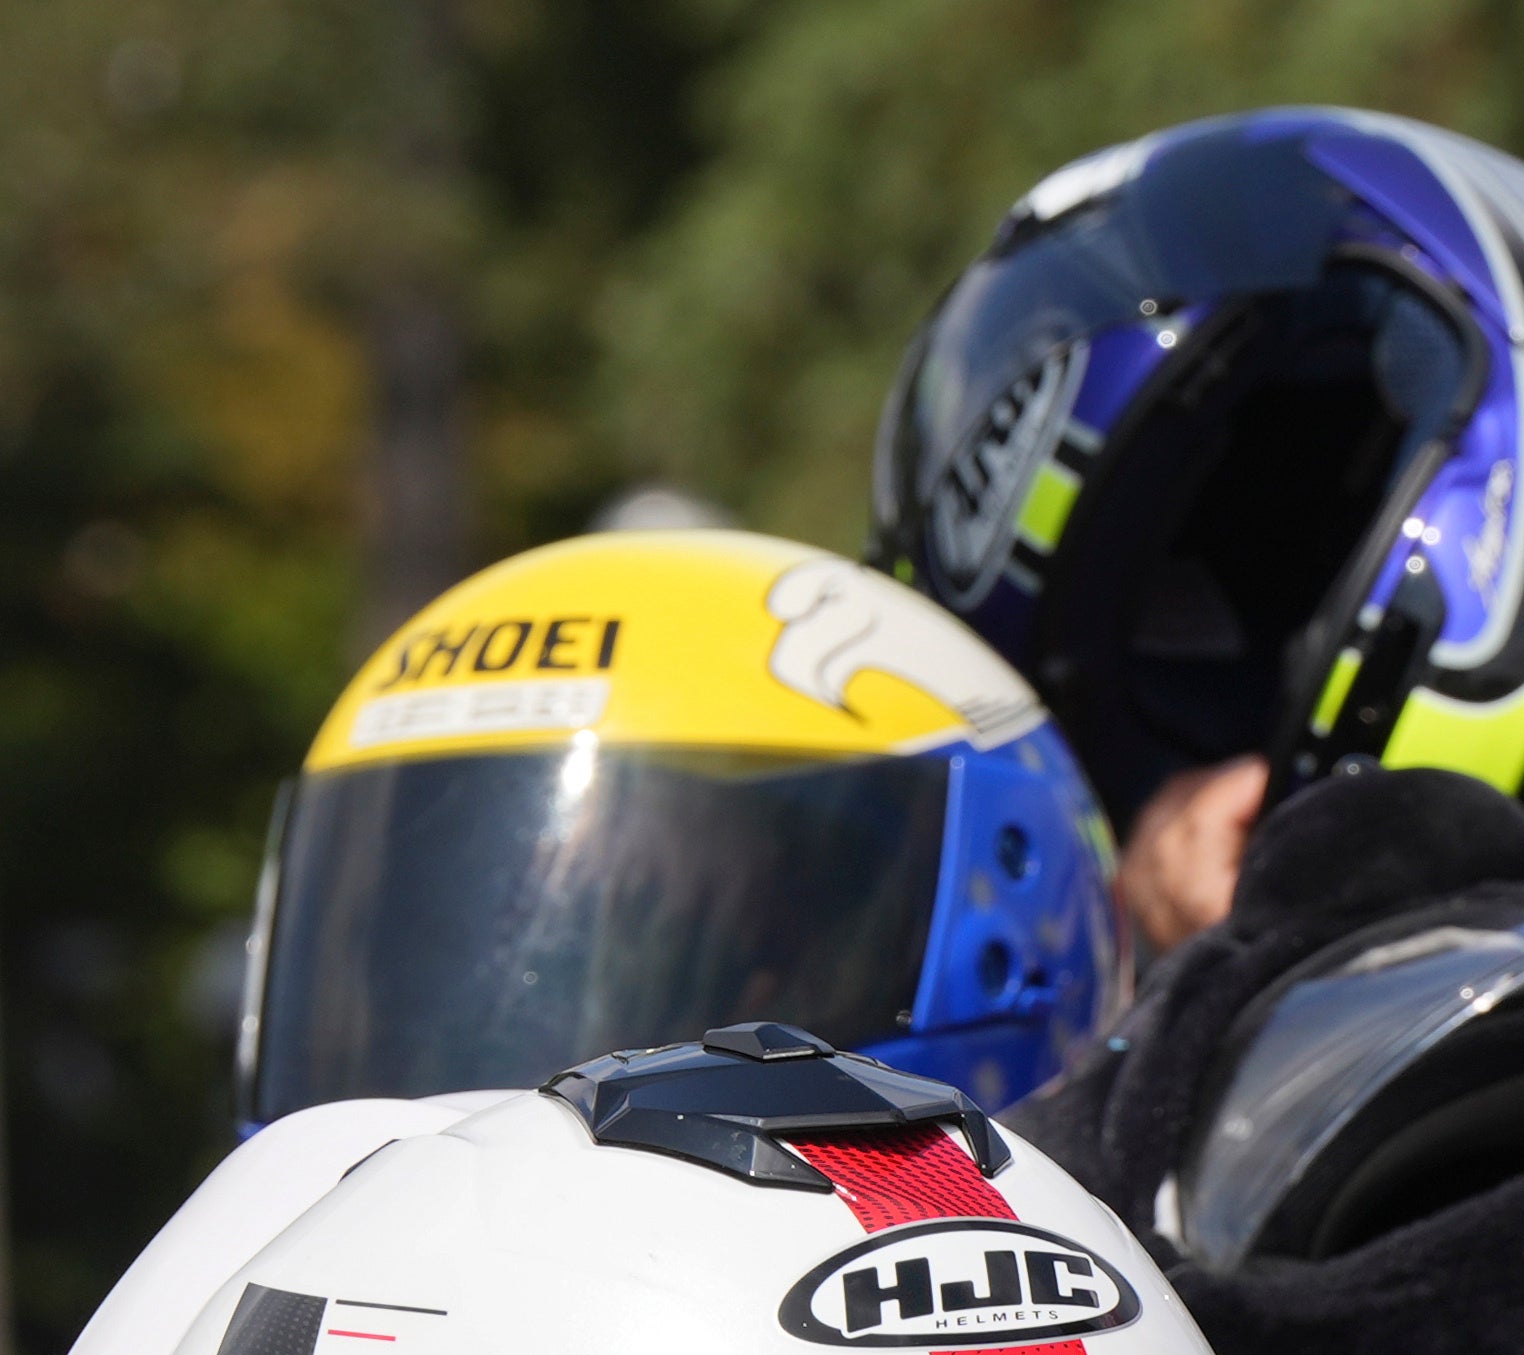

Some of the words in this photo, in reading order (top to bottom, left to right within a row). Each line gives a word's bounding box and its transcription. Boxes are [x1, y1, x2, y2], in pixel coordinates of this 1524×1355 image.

[374, 616, 622, 692] SHOEI
[842, 1249, 1101, 1334] HJC
[935, 1309, 1060, 1330] HELMETS
